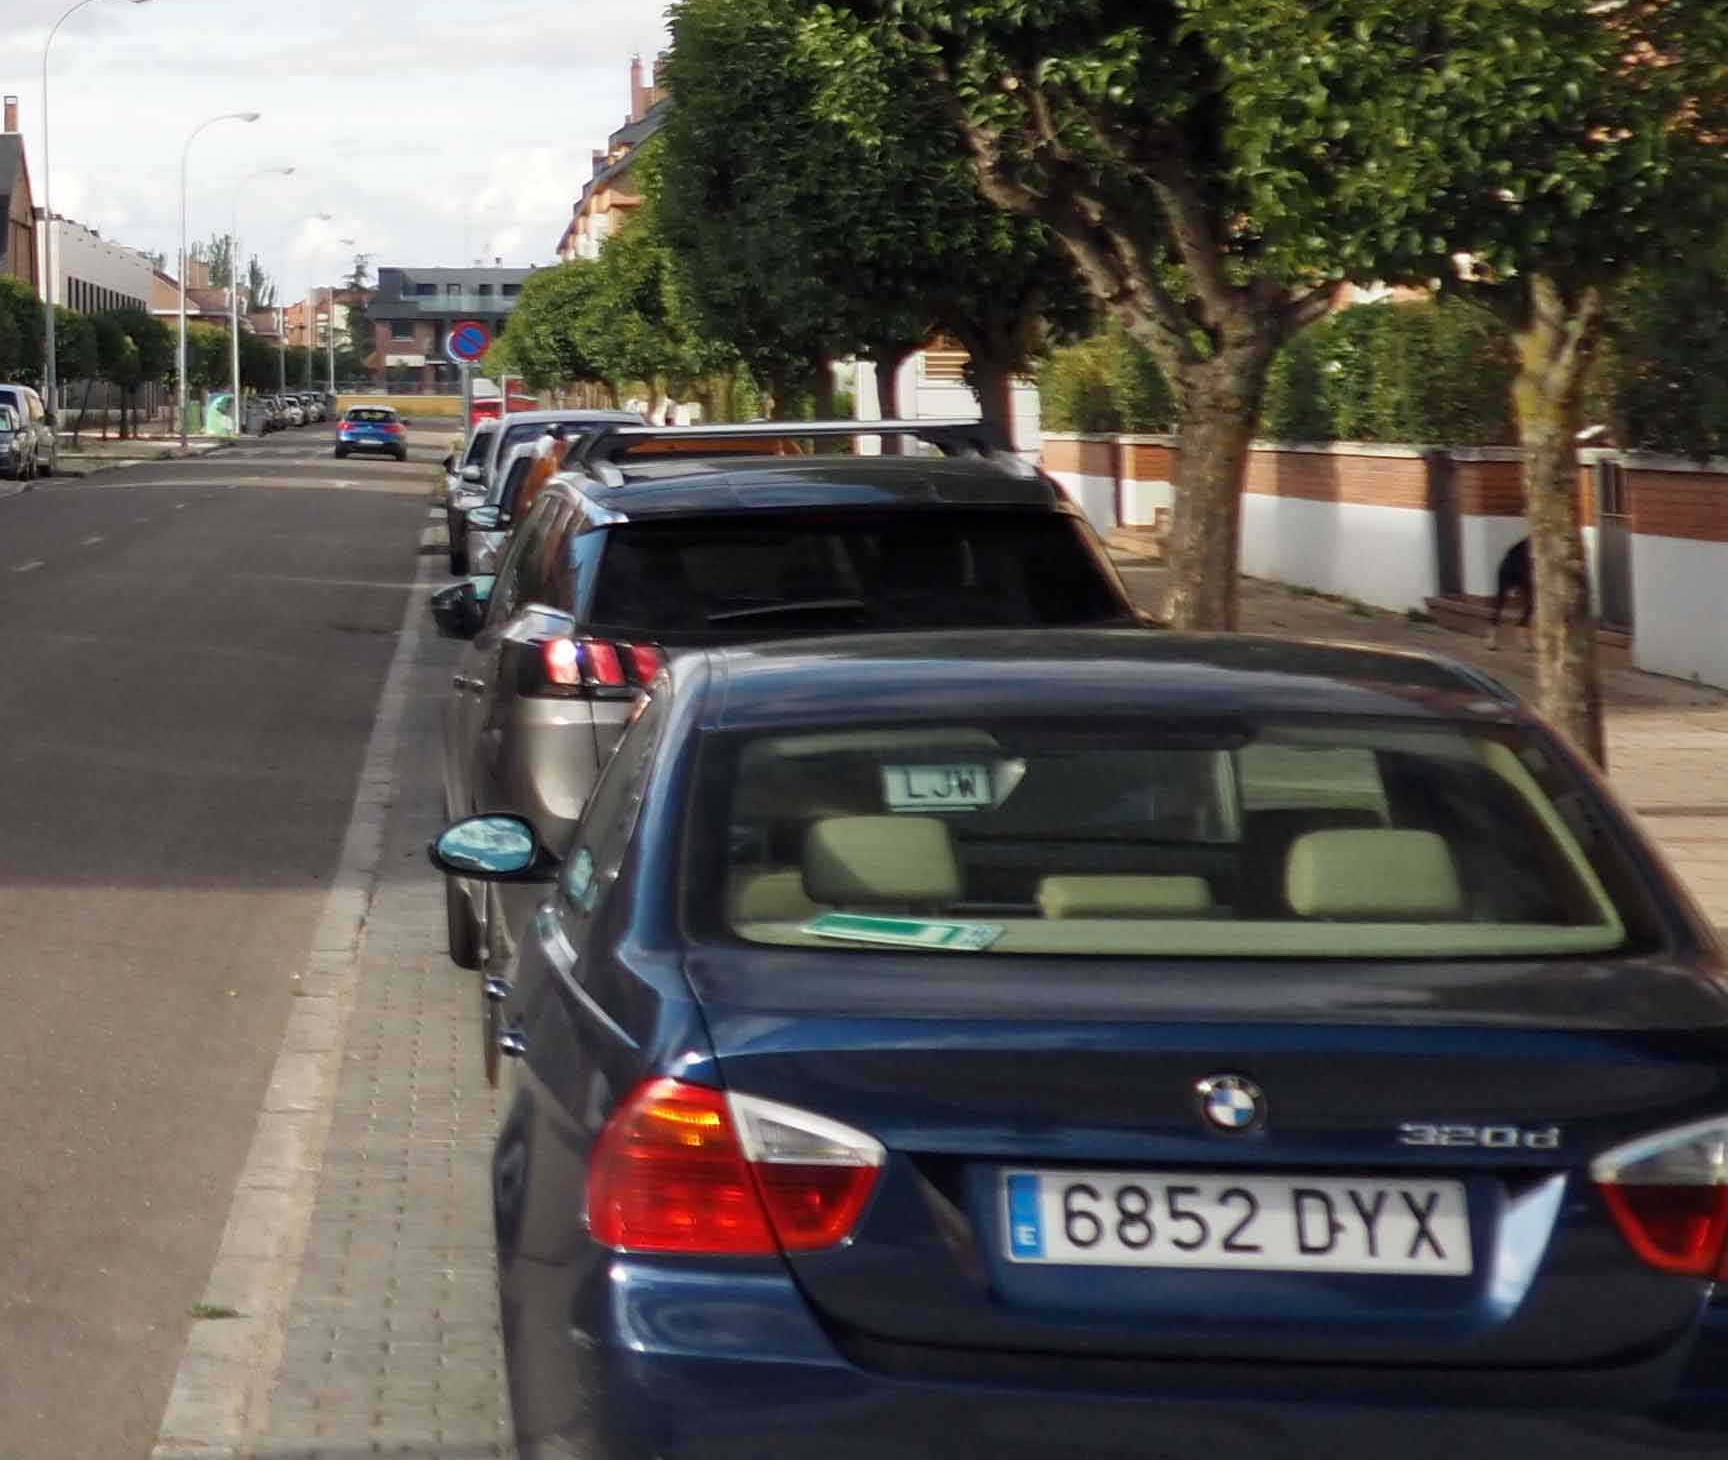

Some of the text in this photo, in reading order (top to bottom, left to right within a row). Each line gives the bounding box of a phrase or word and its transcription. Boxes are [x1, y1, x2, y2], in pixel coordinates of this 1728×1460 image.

[905, 768, 977, 799] LJW
[1400, 1123, 1560, 1149] 320d
[1018, 1183, 1447, 1260] E 6852 DYX
